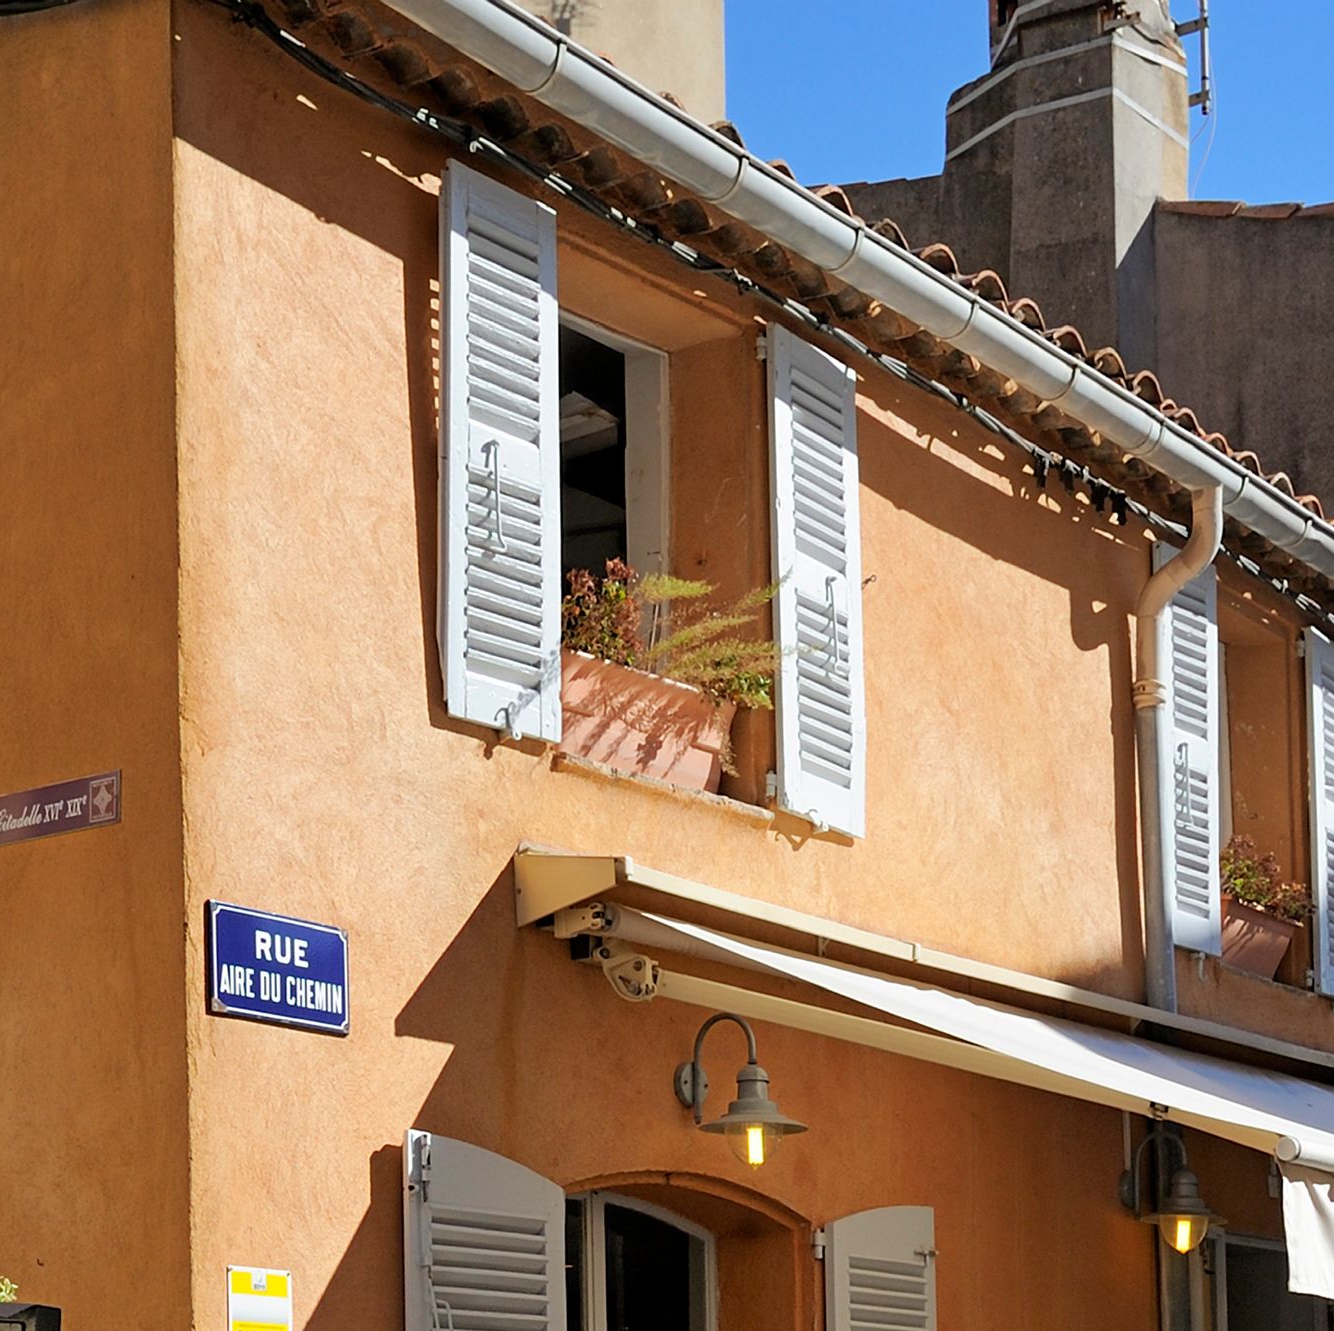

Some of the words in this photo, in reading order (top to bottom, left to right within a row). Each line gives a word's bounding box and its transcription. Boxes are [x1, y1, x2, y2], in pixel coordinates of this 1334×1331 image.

[254, 929, 309, 969] RUE
[219, 963, 256, 999] AIRE
[259, 970, 281, 1003] DU
[285, 975, 343, 1015] CHEMIN
